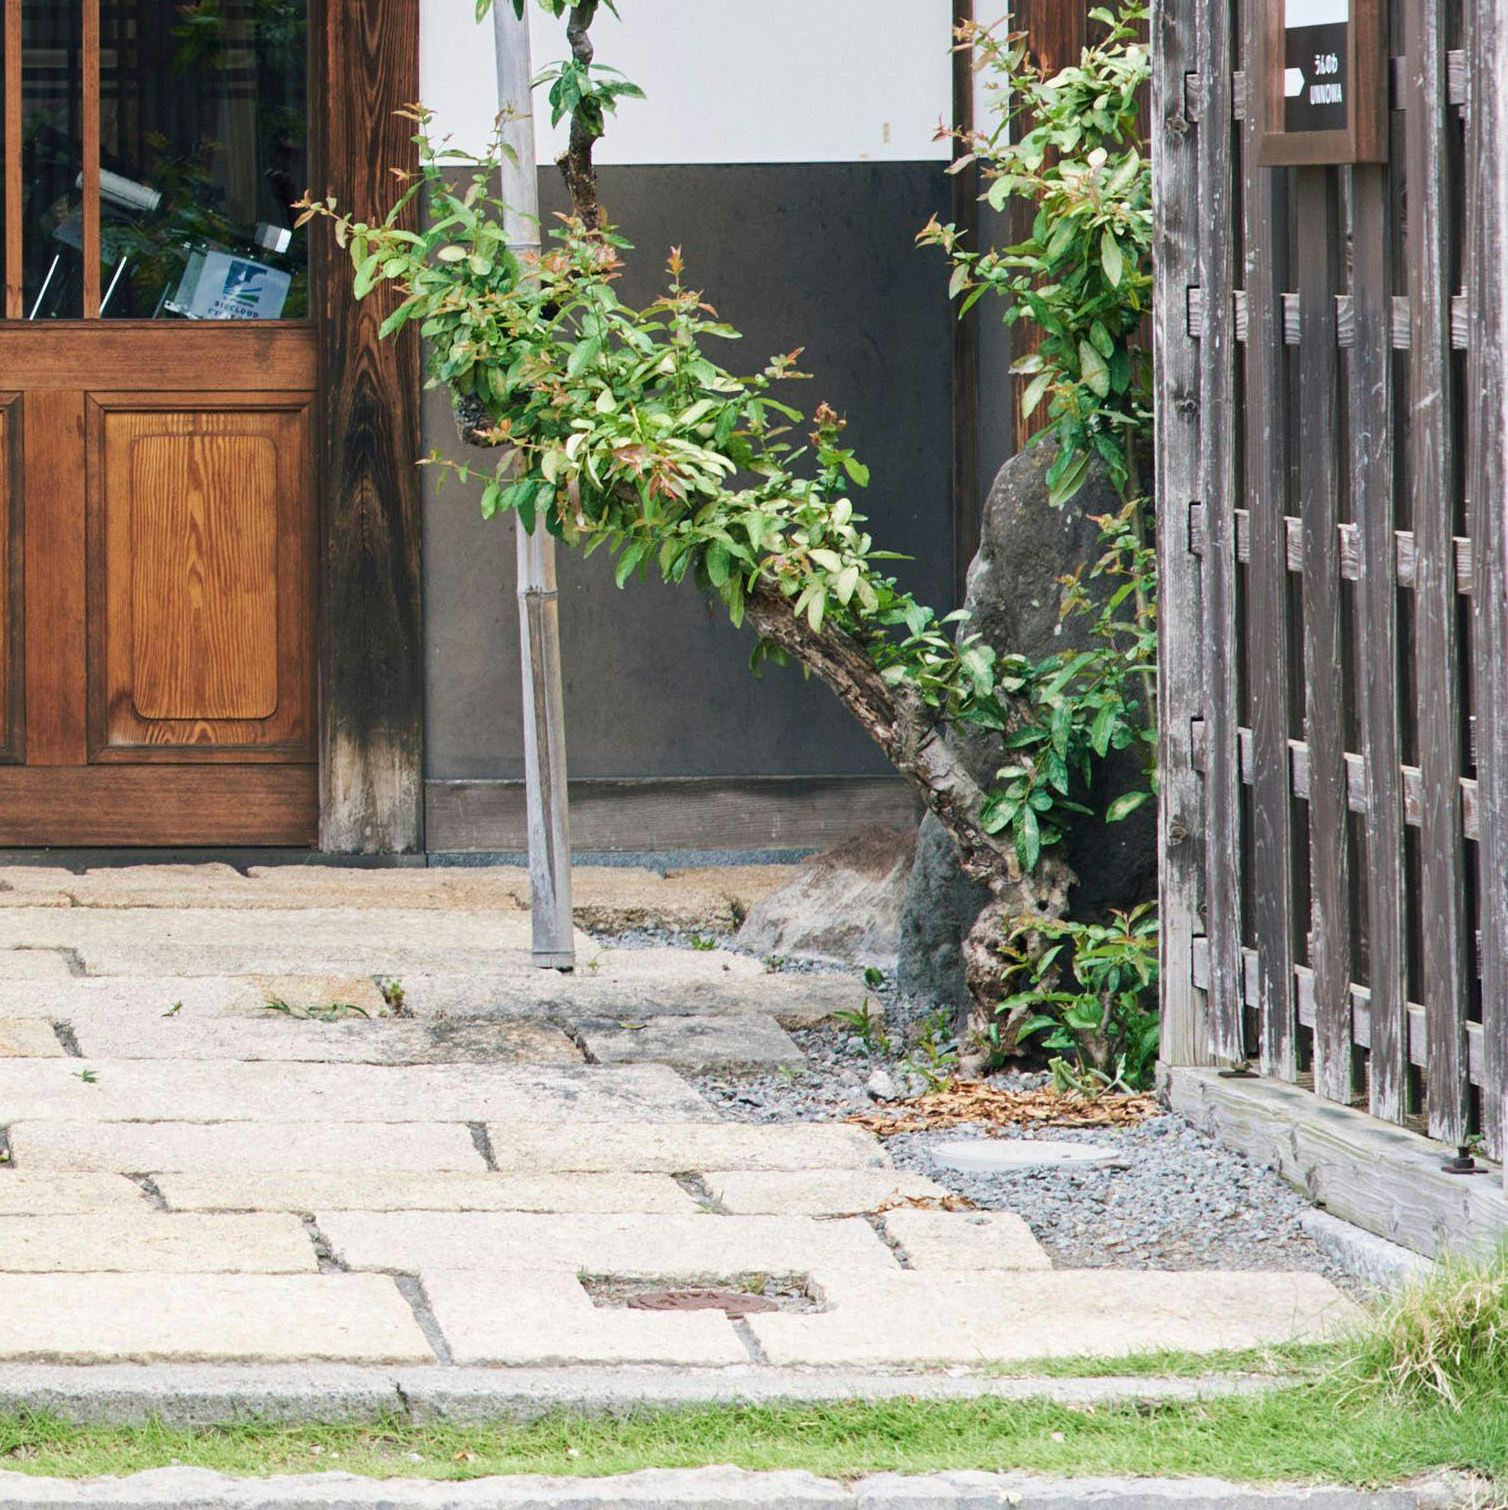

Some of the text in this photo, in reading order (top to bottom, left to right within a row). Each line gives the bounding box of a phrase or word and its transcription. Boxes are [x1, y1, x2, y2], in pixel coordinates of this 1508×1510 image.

[1314, 53, 1338, 76] うんのわ
[1310, 83, 1342, 105] UNNOWA
